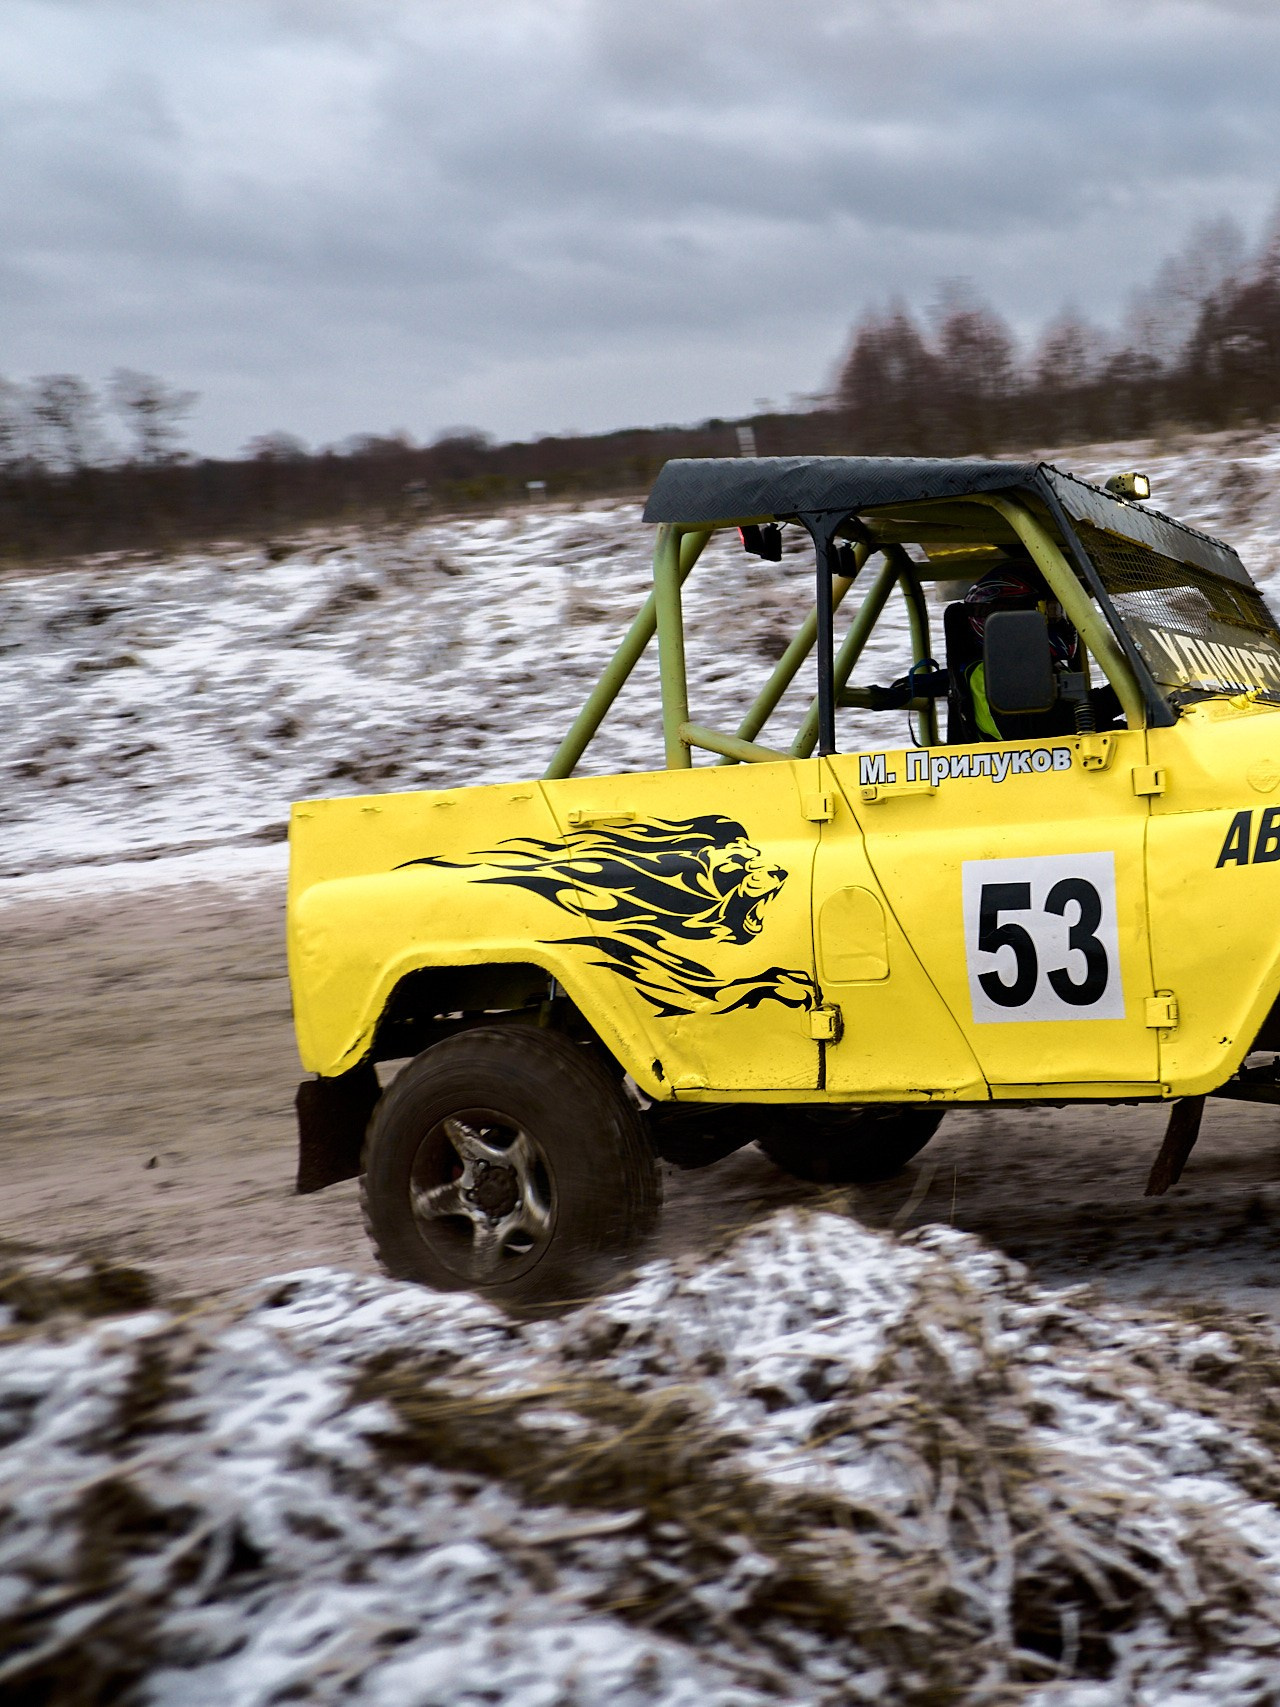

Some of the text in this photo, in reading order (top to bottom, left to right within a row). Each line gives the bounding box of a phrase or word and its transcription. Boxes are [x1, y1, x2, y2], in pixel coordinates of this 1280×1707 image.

[859, 750, 1072, 787] М. Прилуков
[977, 877, 1109, 1008] 53
